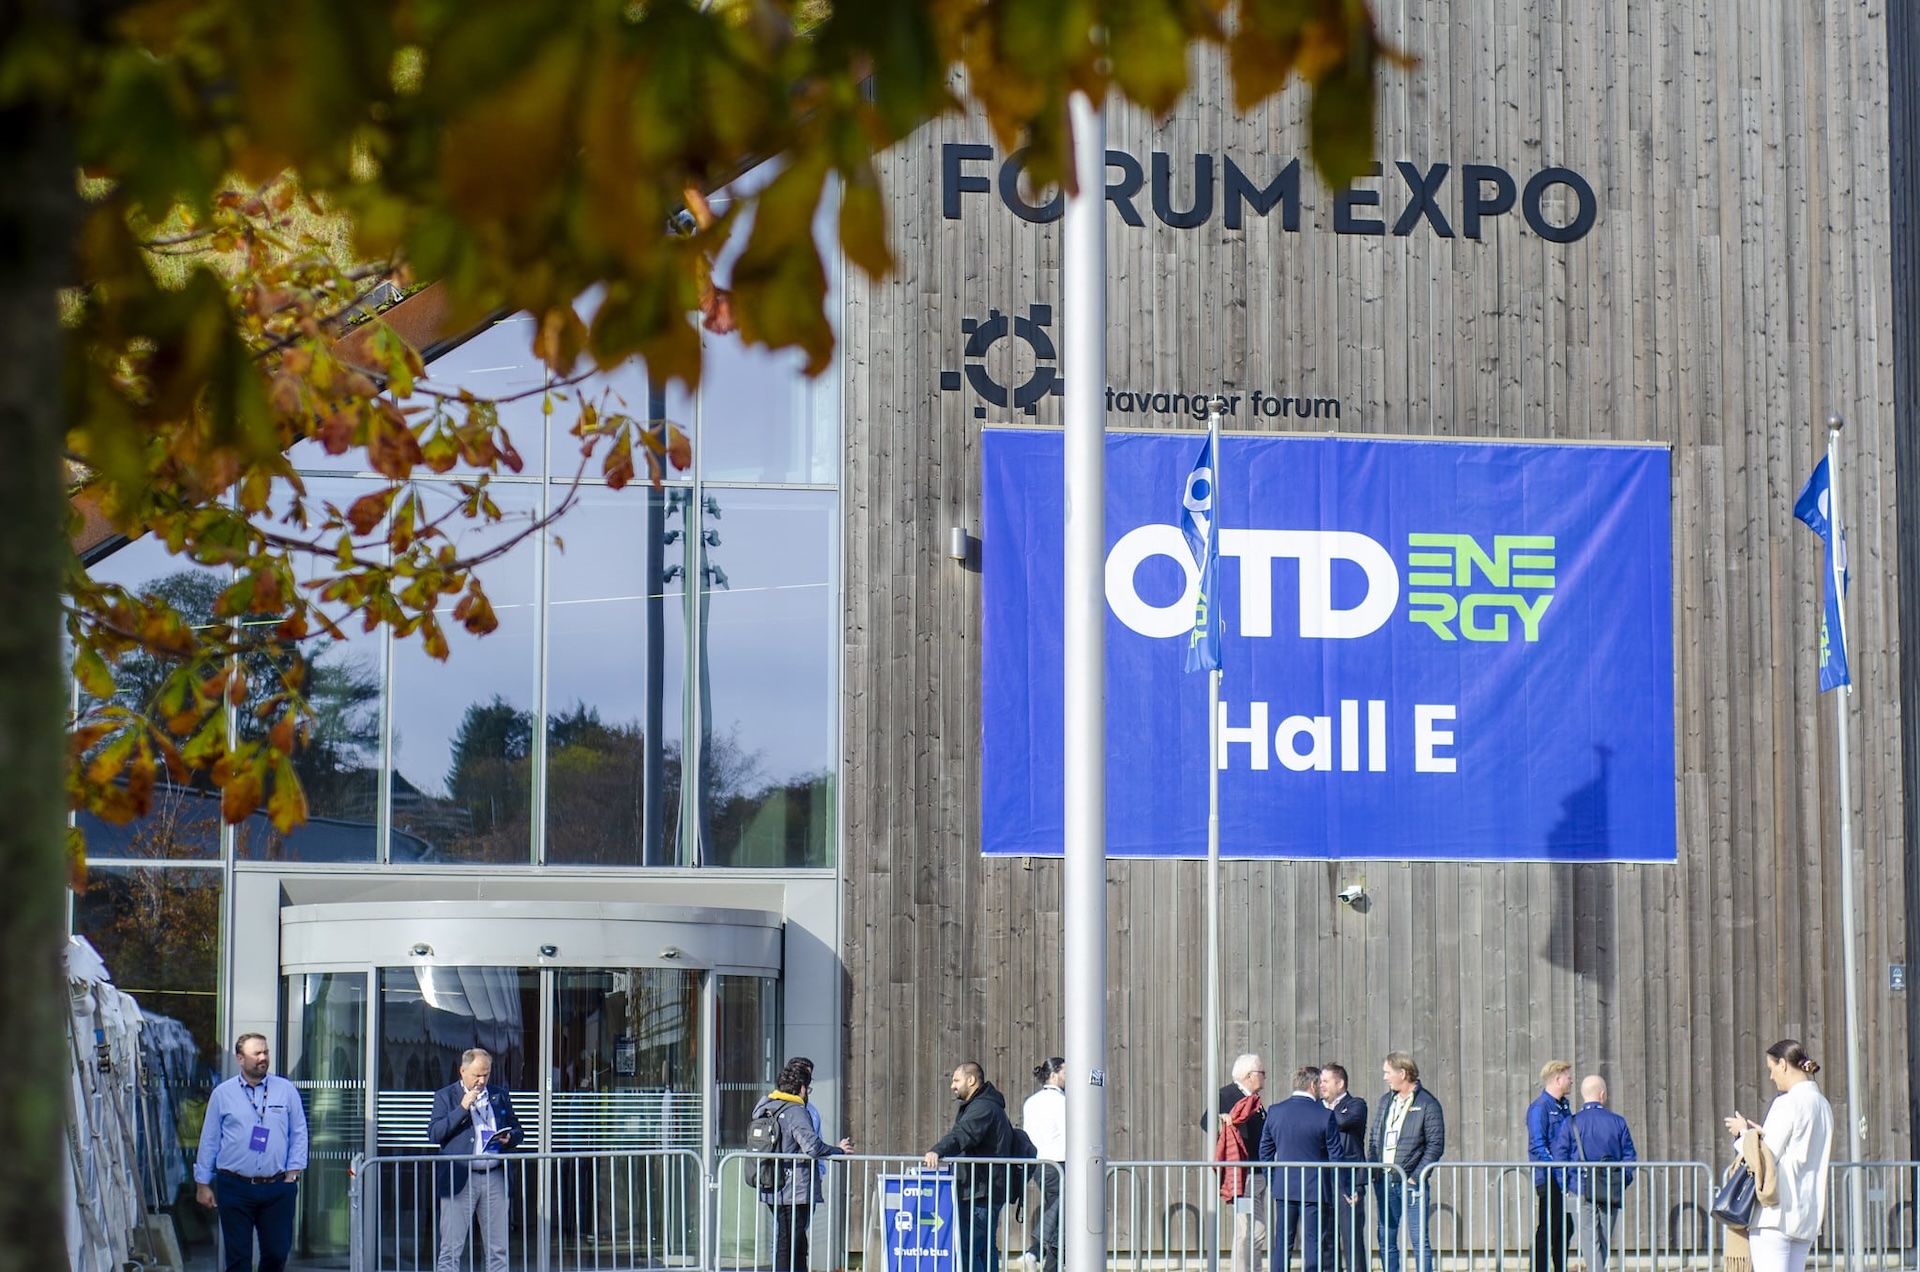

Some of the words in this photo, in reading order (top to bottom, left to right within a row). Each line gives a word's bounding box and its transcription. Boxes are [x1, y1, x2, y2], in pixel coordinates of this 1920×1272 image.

[943, 143, 1300, 232] FORUM
[1333, 161, 1597, 243] EXPO
[1105, 386, 1241, 420] tavanger
[1252, 390, 1341, 419] forum
[1105, 524, 1399, 638] OTD
[1408, 533, 1556, 588] ENE
[1217, 700, 1386, 772] Hall
[1414, 704, 1457, 773] E
